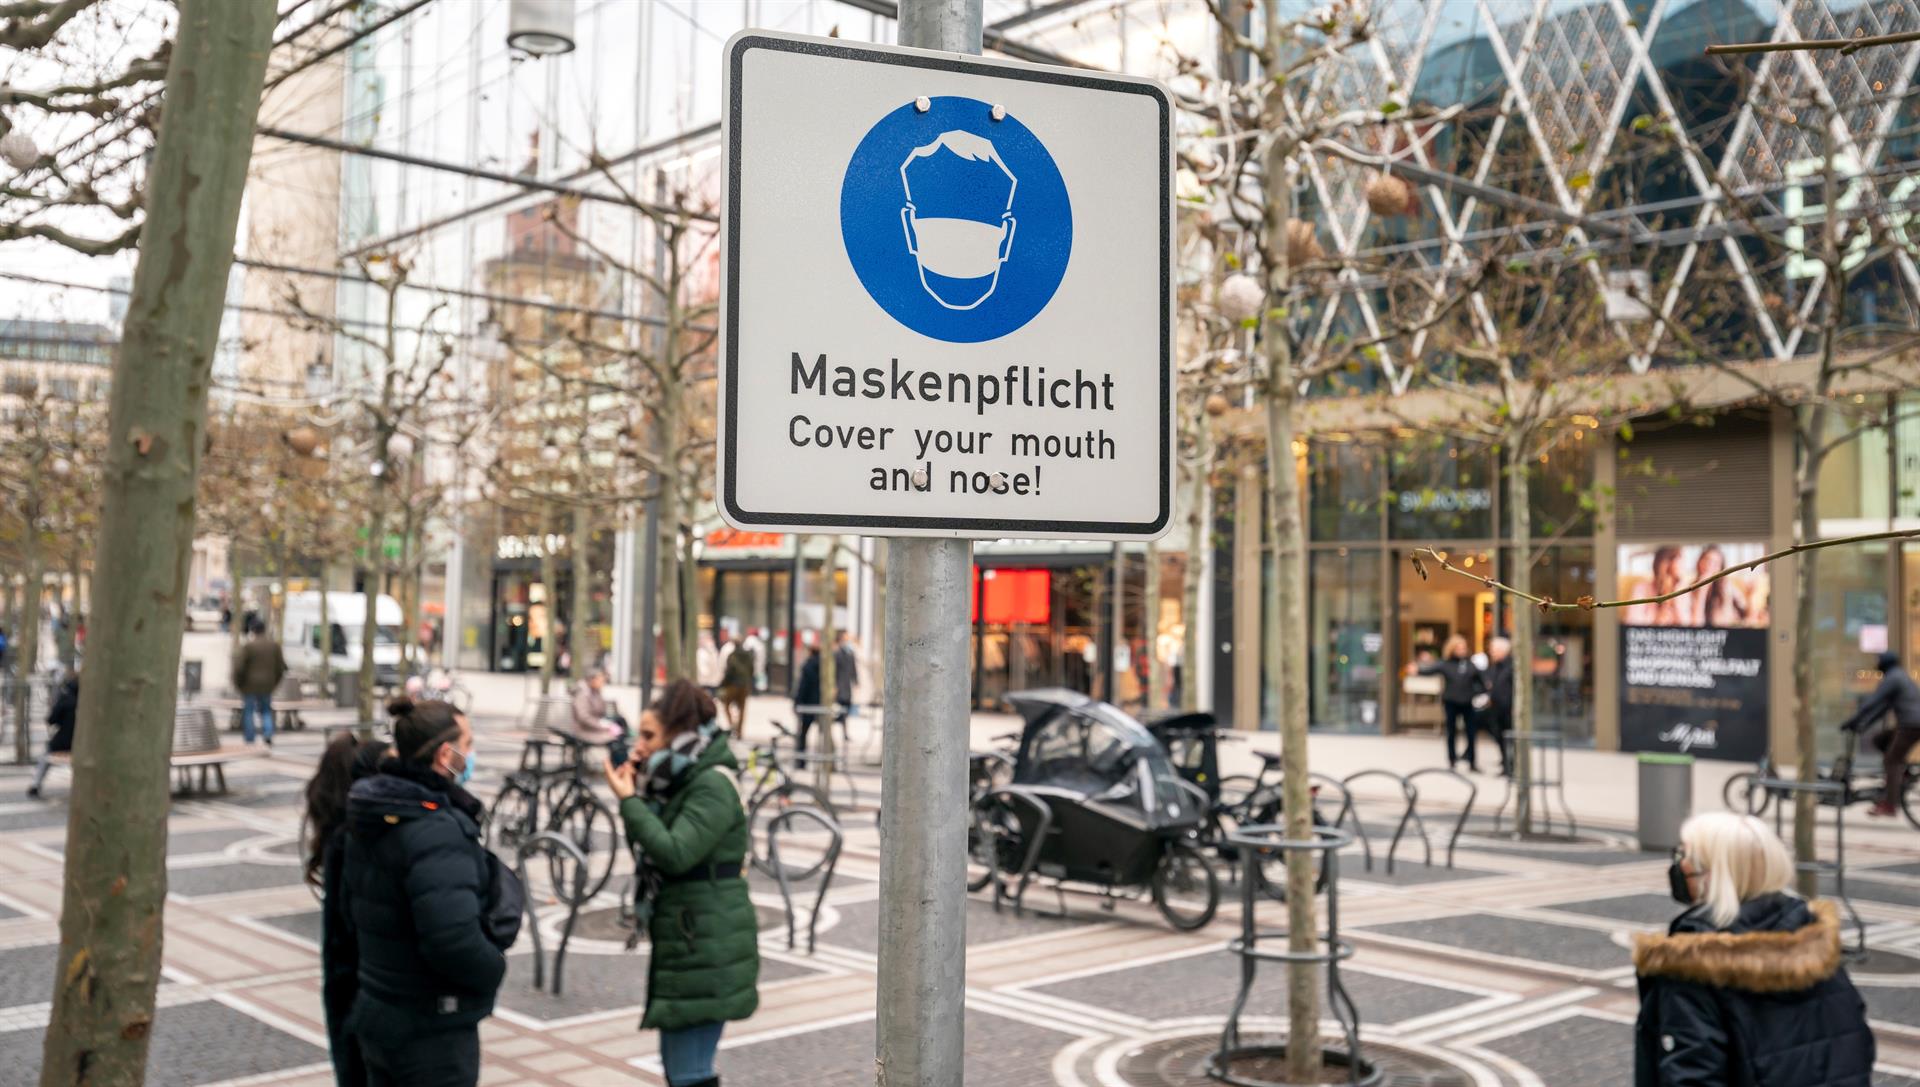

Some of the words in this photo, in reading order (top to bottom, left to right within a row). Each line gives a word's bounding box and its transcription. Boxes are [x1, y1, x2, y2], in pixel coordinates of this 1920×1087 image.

[791, 352, 1115, 415] Maskenpflicht
[789, 415, 894, 450] Cover
[915, 428, 992, 460] your
[1011, 430, 1116, 460] mouth
[870, 461, 932, 492] and
[950, 465, 1041, 496] nose!
[1400, 488, 1491, 512] SWROSKI
[1698, 658, 1762, 676] VIELFALT
